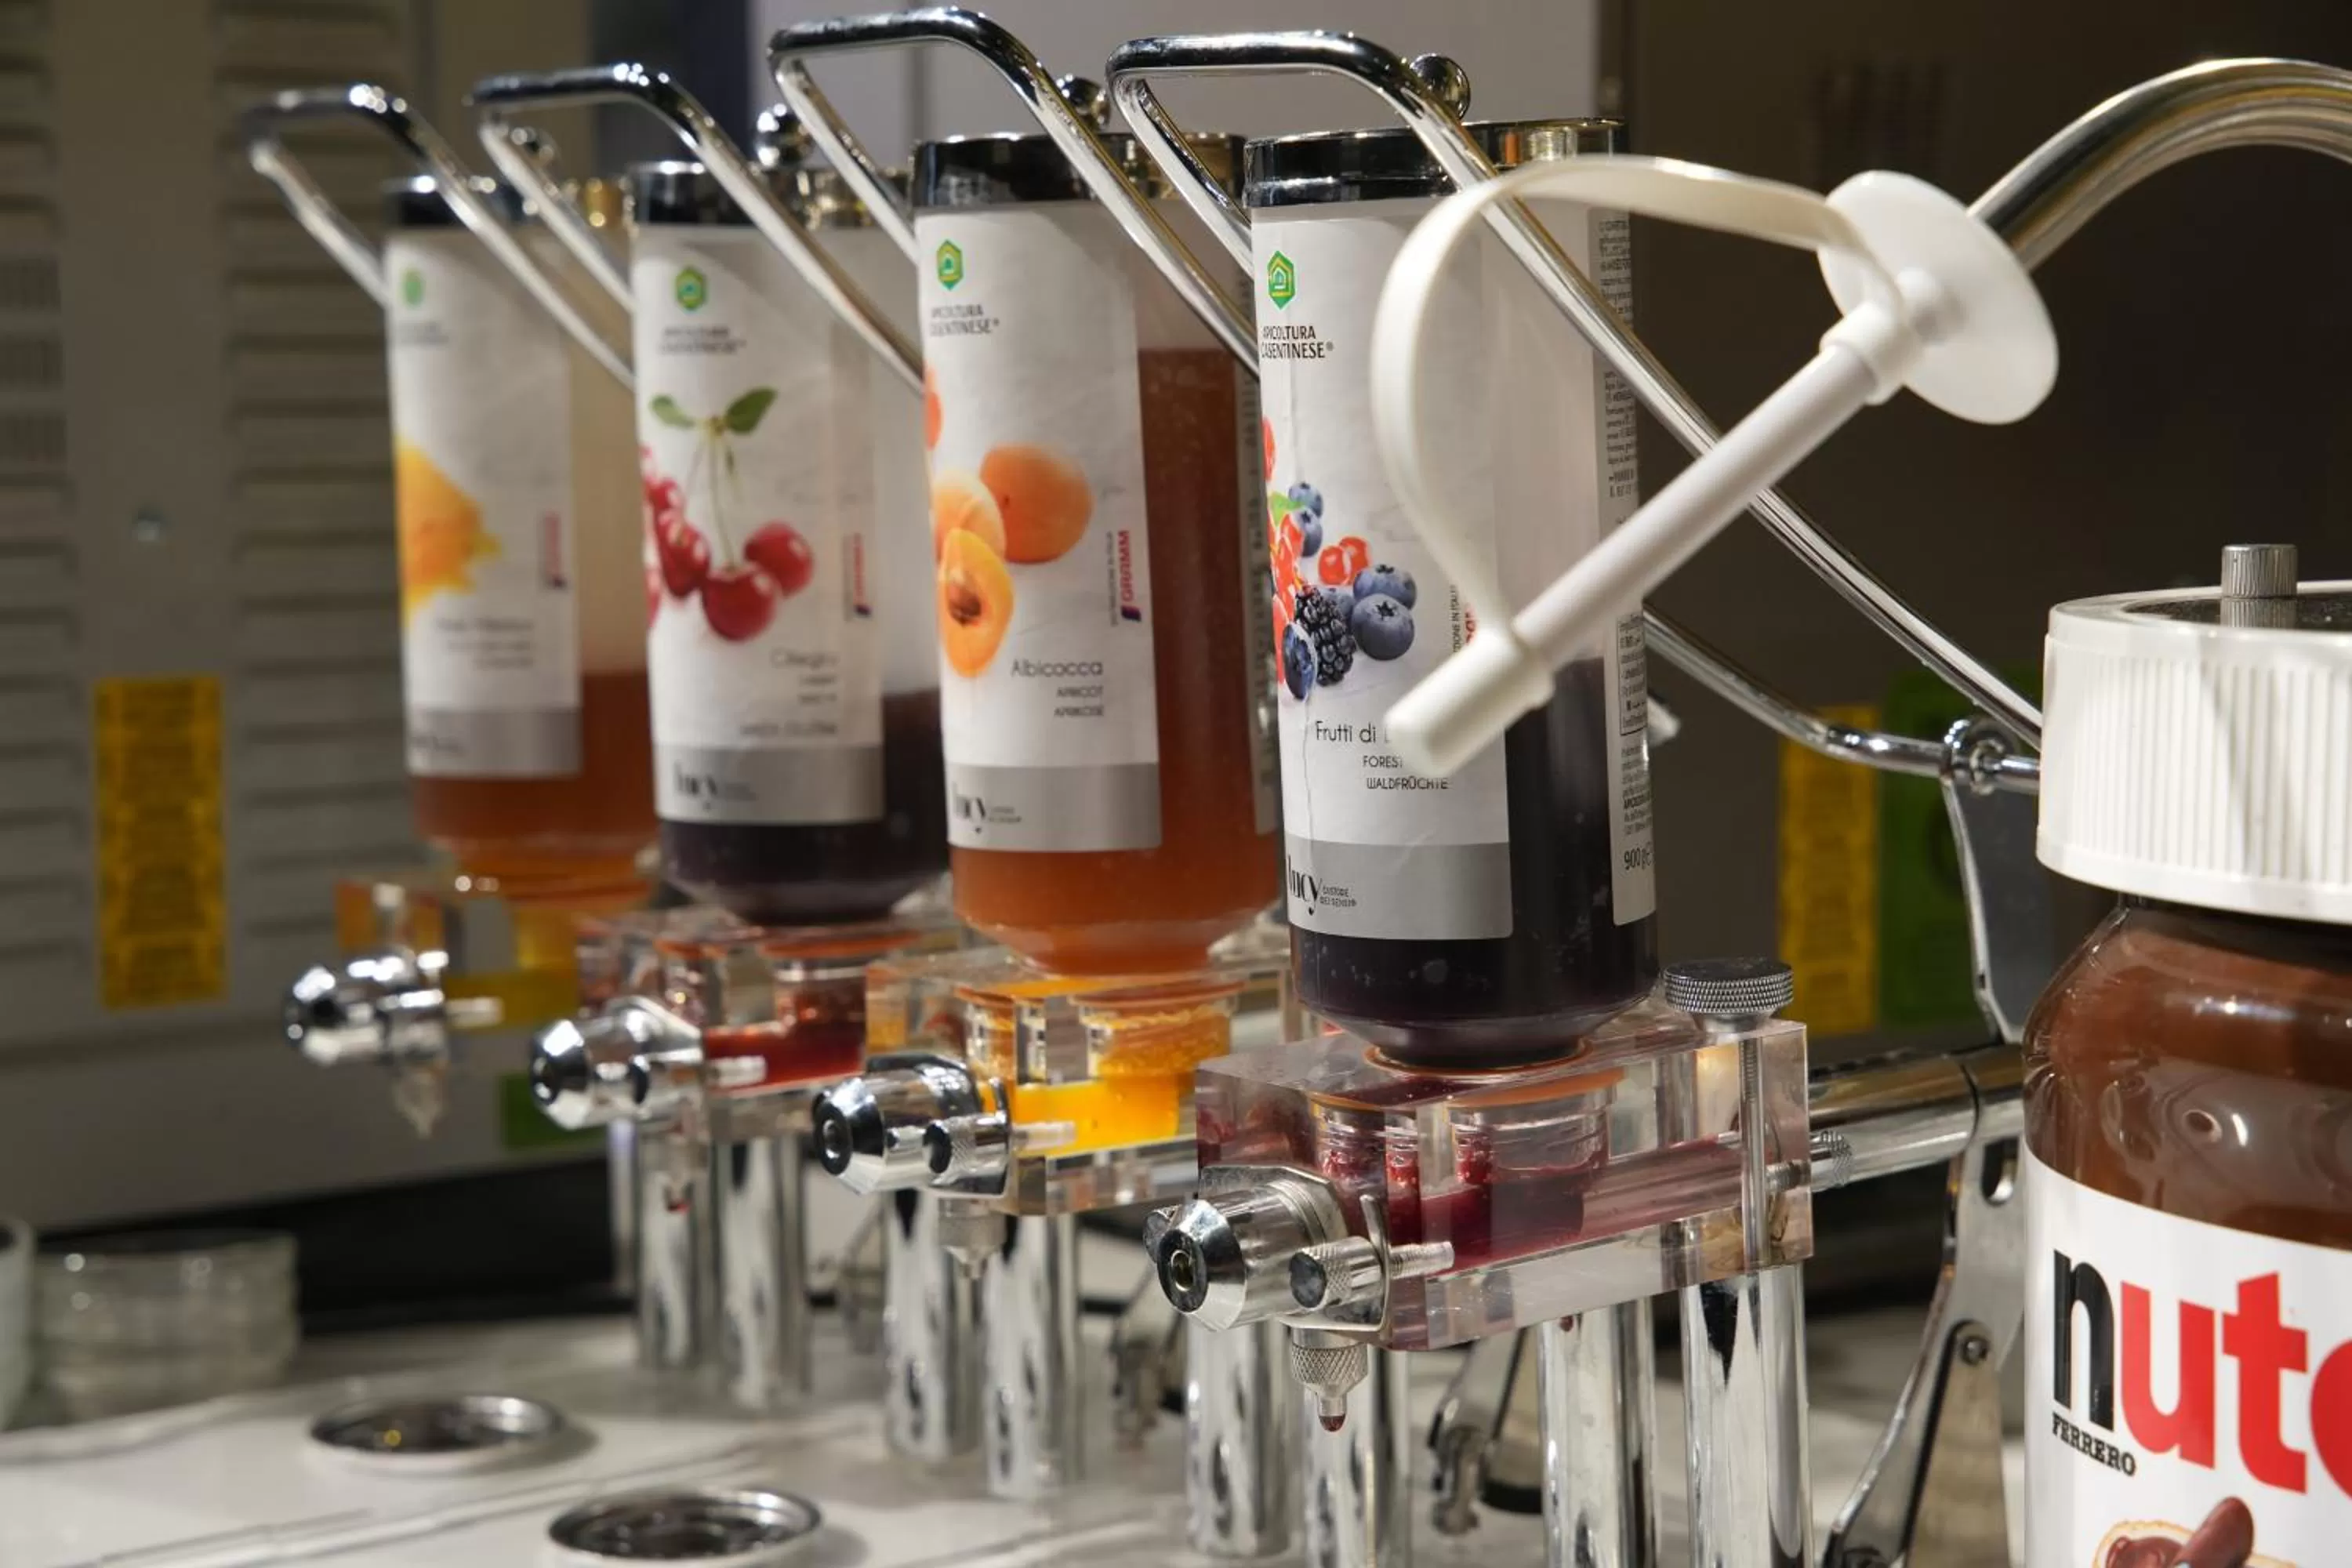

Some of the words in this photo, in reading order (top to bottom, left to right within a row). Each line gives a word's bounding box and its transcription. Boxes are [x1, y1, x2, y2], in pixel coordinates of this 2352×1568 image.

[1010, 658, 1105, 679] Albicocca
[1315, 720, 1353, 742] Frutti
[1359, 722, 1377, 743] di
[2052, 1410, 2136, 1476] FERRERO
